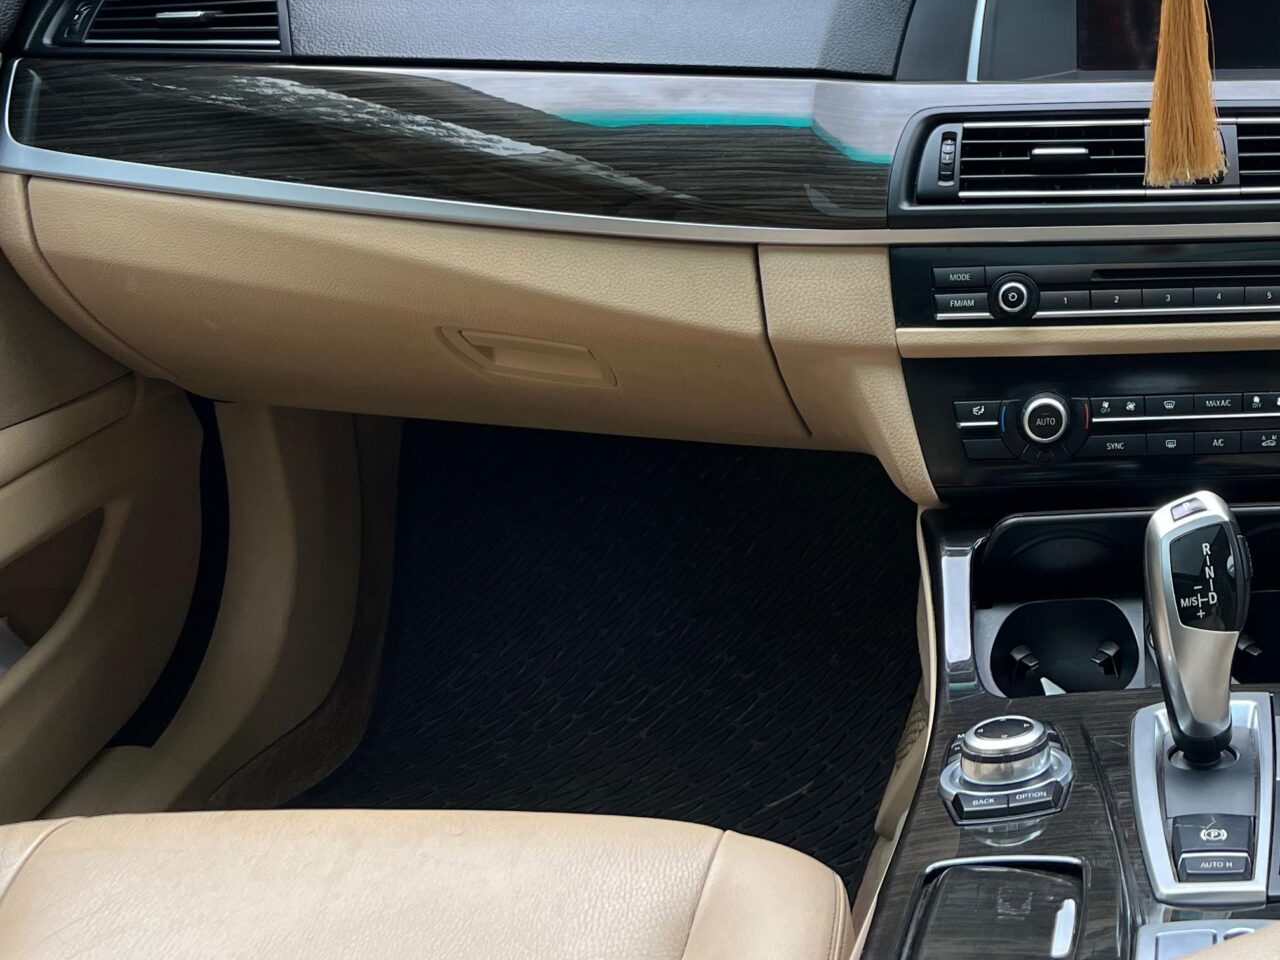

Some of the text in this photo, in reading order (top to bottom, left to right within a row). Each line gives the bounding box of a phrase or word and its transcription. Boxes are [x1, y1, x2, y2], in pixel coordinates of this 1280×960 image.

[949, 273, 971, 281] MODE
[1114, 295, 1120, 304] 2
[1166, 294, 1172, 303] 3
[1216, 292, 1222, 301] 4
[1267, 291, 1273, 300] 5
[949, 299, 975, 308] FM/AM
[1063, 296, 1068, 305] 1
[1035, 417, 1056, 427] AUTO
[1106, 442, 1125, 451] SYNC
[1212, 438, 1225, 447] A/C
[1202, 543, 1211, 555] R
[1205, 566, 1214, 578] N
[1180, 592, 1217, 608] M/S D
[1015, 790, 1047, 800] OPTION
[972, 797, 995, 806] BACK
[1200, 861, 1223, 869] AUTO
